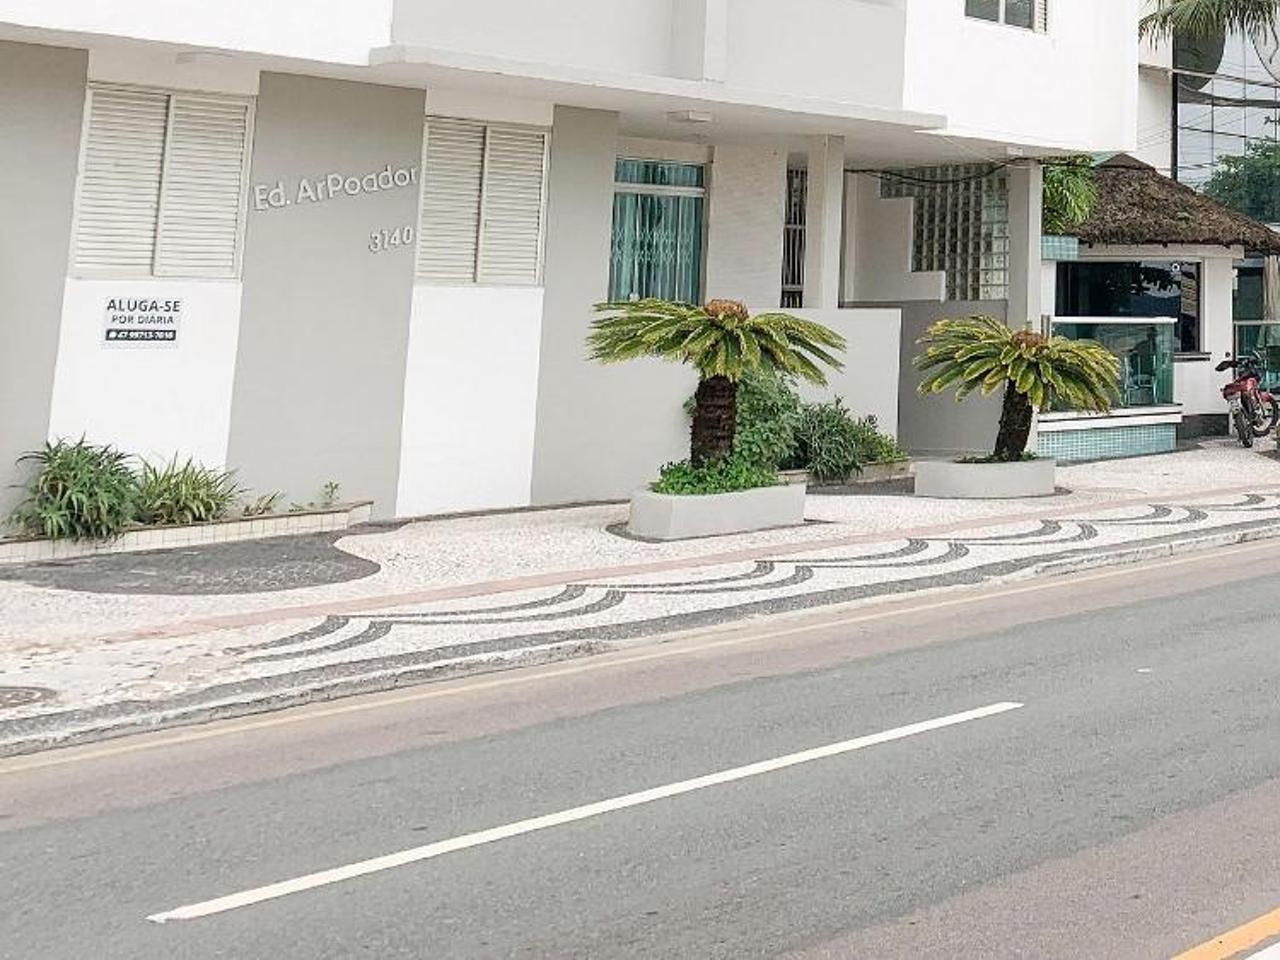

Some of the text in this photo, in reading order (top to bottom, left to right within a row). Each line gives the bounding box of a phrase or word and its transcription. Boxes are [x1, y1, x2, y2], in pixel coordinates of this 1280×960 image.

[253, 183, 291, 211] Ed.
[367, 225, 414, 253] 3140
[106, 299, 181, 312] ALUGA-SE
[112, 314, 134, 325] POR
